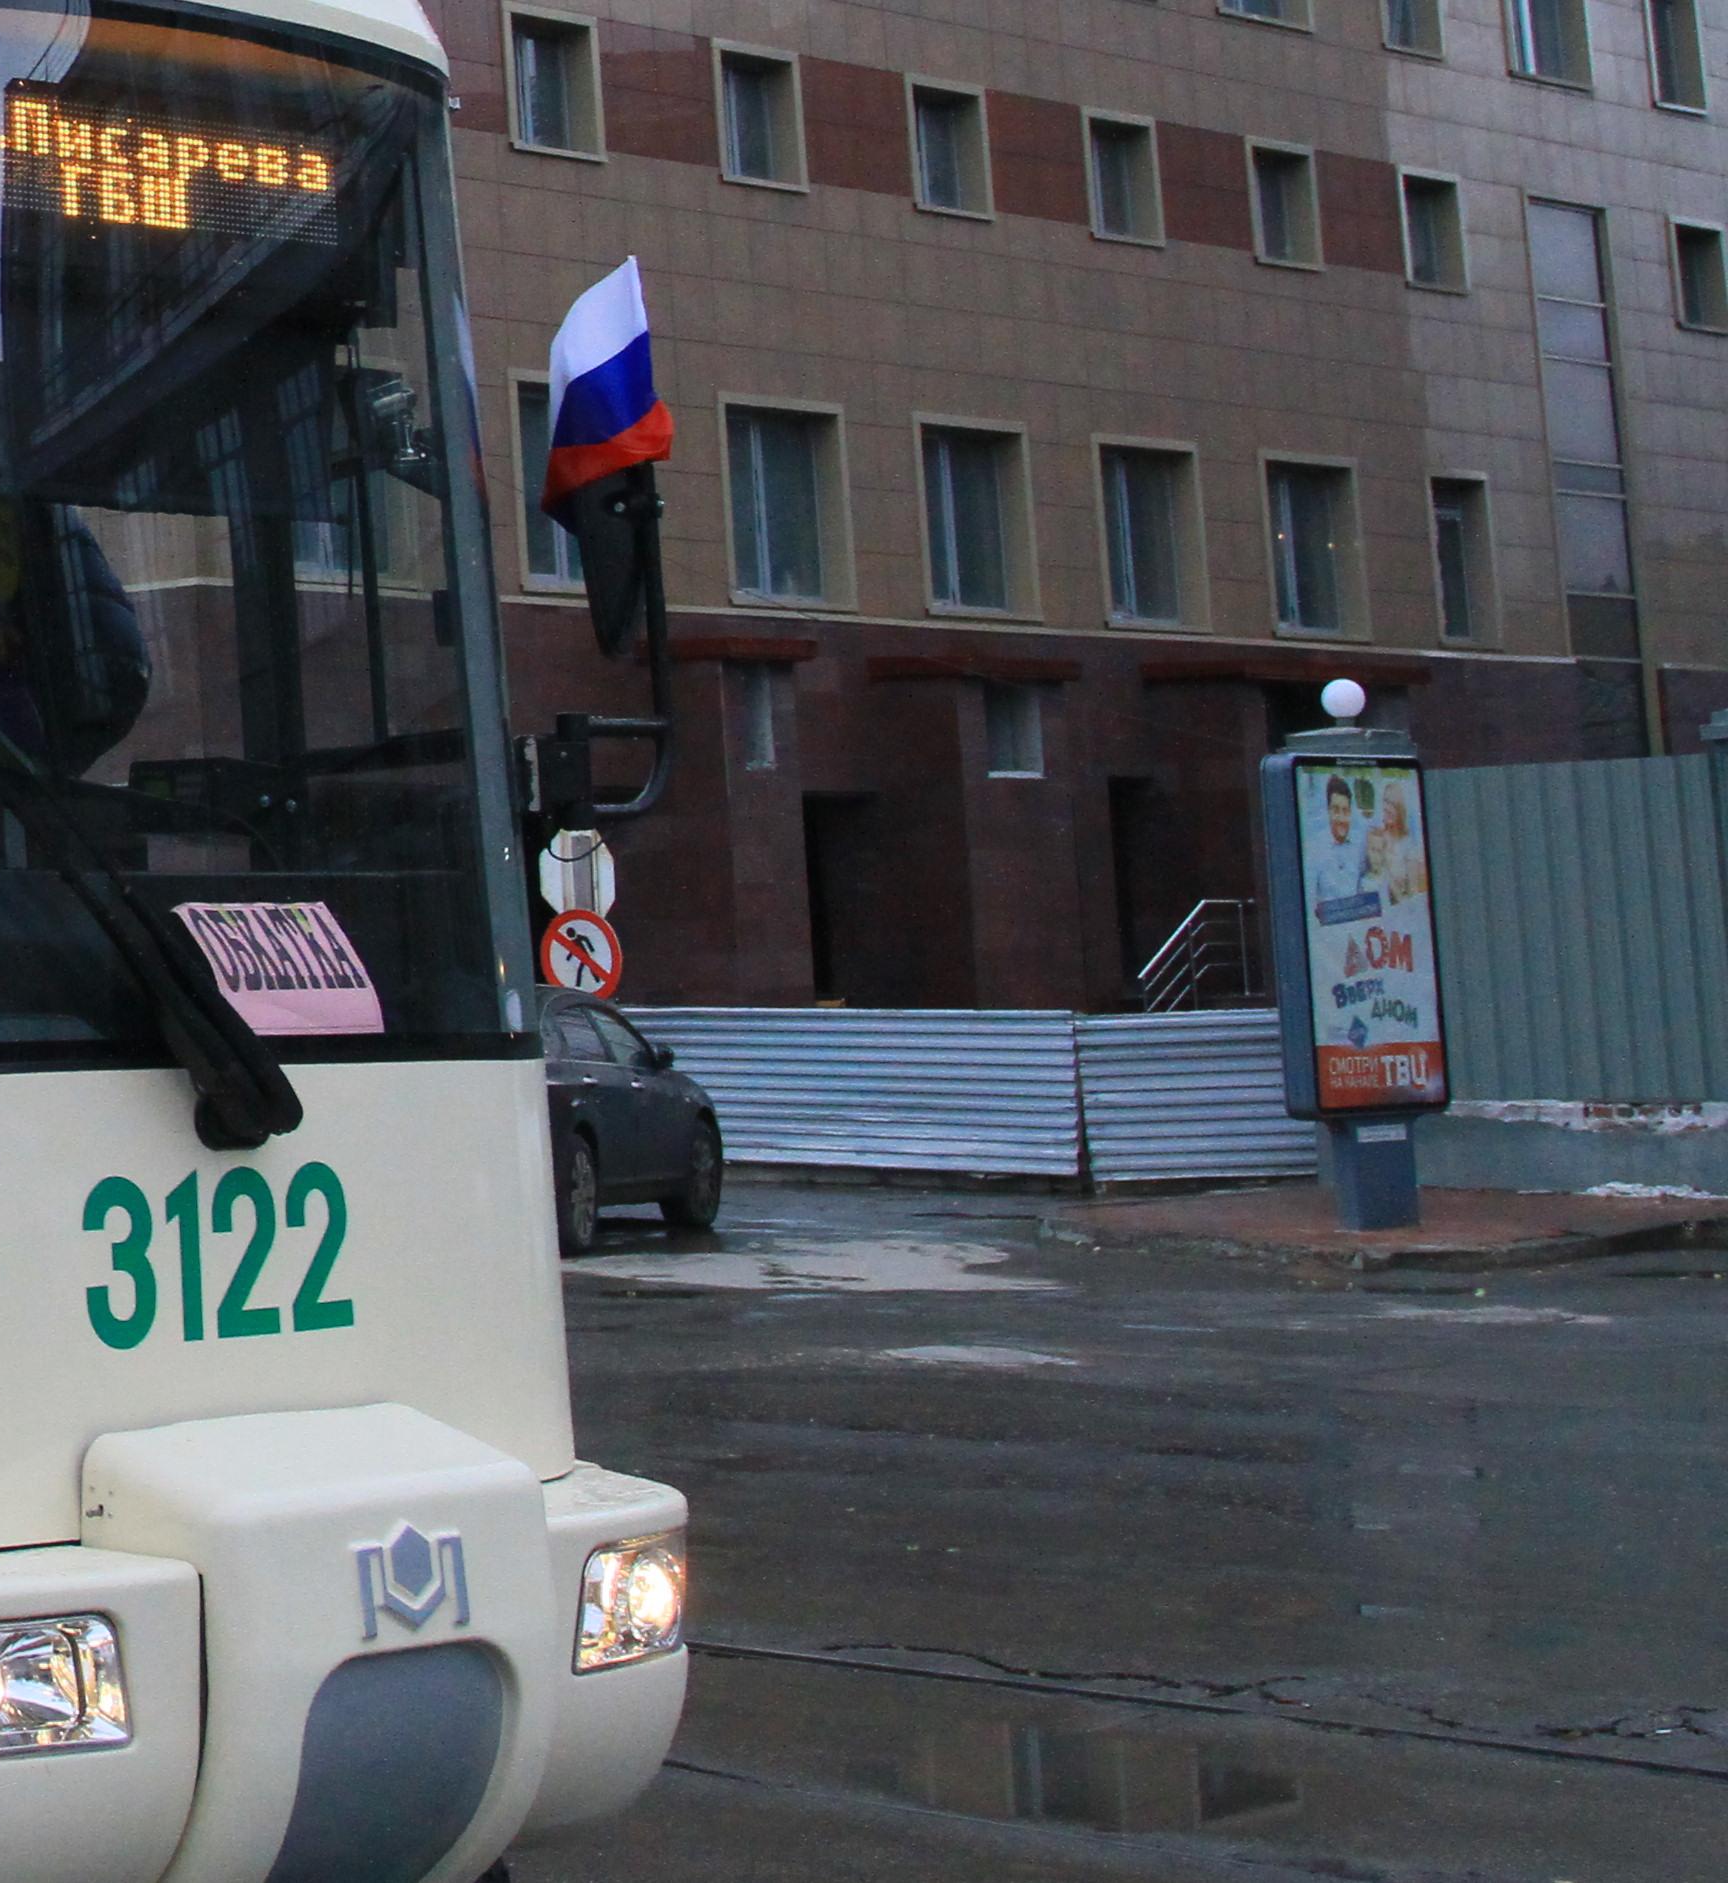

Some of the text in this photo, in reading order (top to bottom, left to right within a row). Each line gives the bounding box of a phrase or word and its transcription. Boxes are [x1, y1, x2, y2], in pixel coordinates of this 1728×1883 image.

[188, 907, 368, 993] ОБКАТКА
[1329, 1053, 1428, 1092] СМОТРИ ТВЦ
[82, 1161, 354, 1350] 3122
